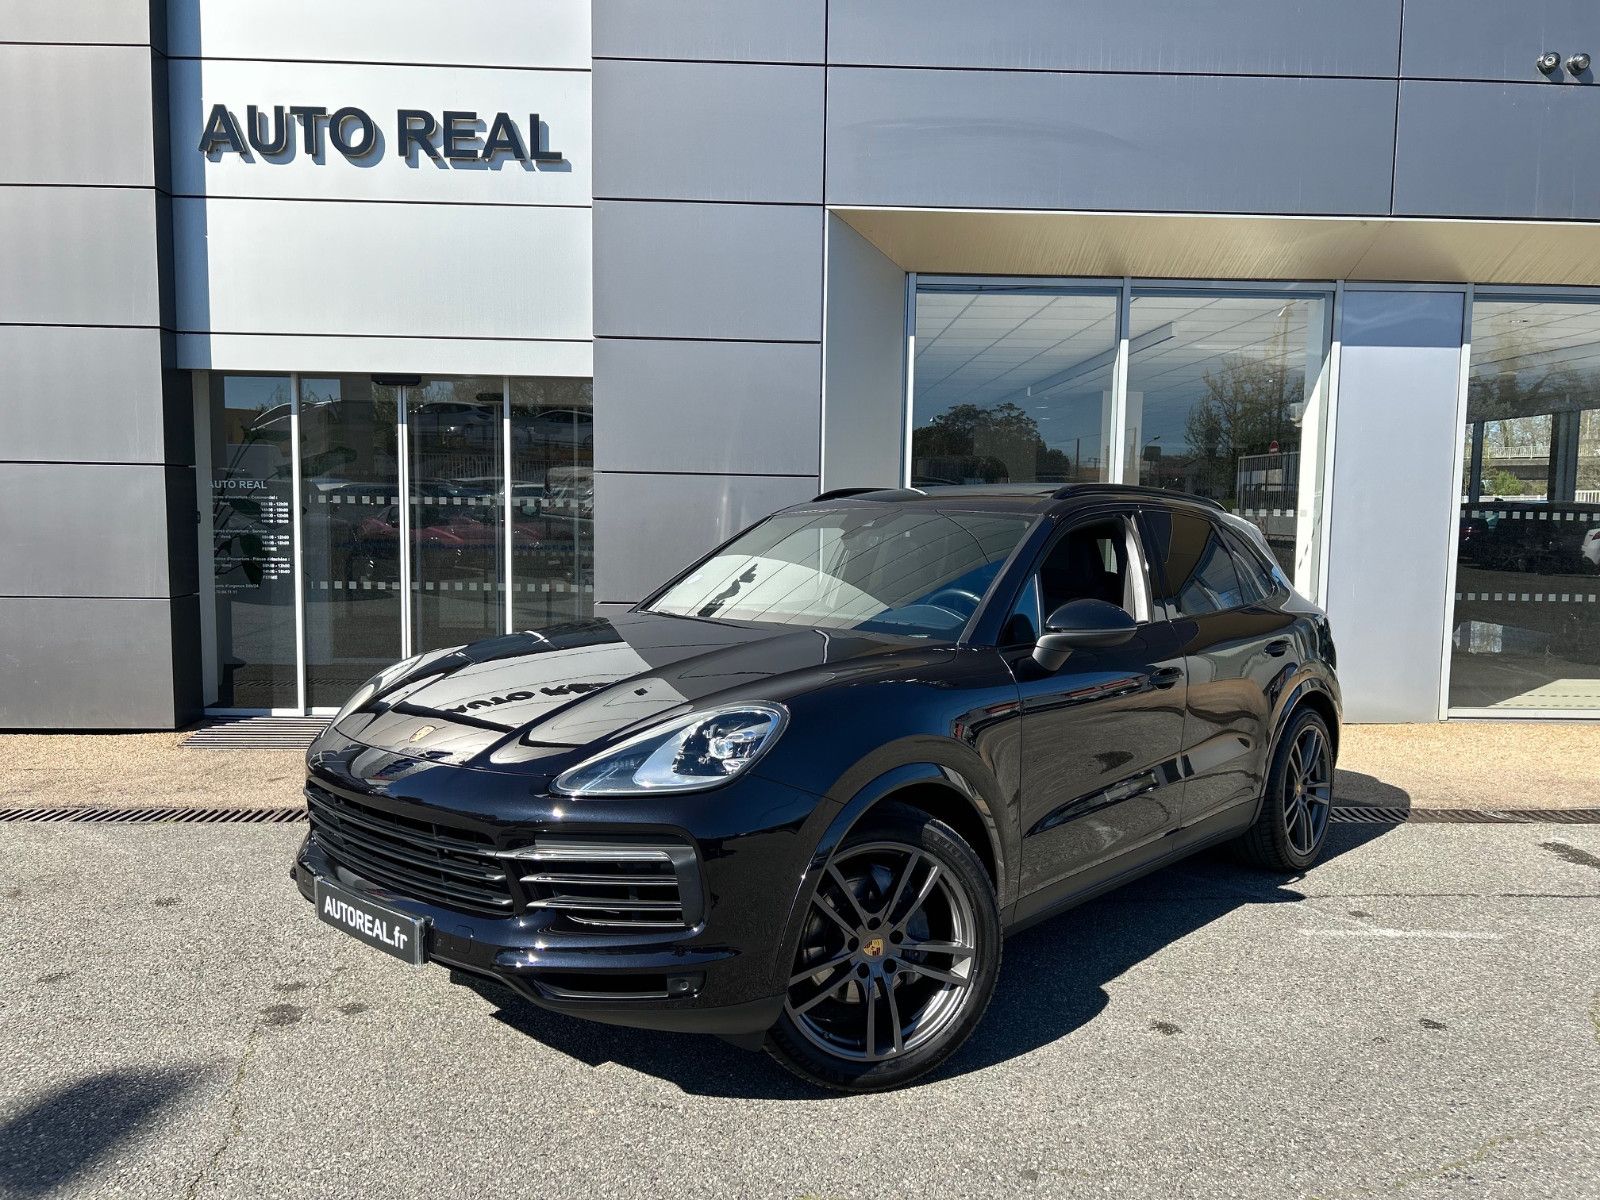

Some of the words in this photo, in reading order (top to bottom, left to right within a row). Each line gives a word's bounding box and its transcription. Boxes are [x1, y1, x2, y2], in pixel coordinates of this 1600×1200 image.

[198, 103, 377, 157] AUTO
[397, 109, 563, 162] REAL
[209, 480, 237, 489] AUTO
[239, 480, 267, 489] REAL
[324, 895, 408, 950] AUTOREAL.fr
